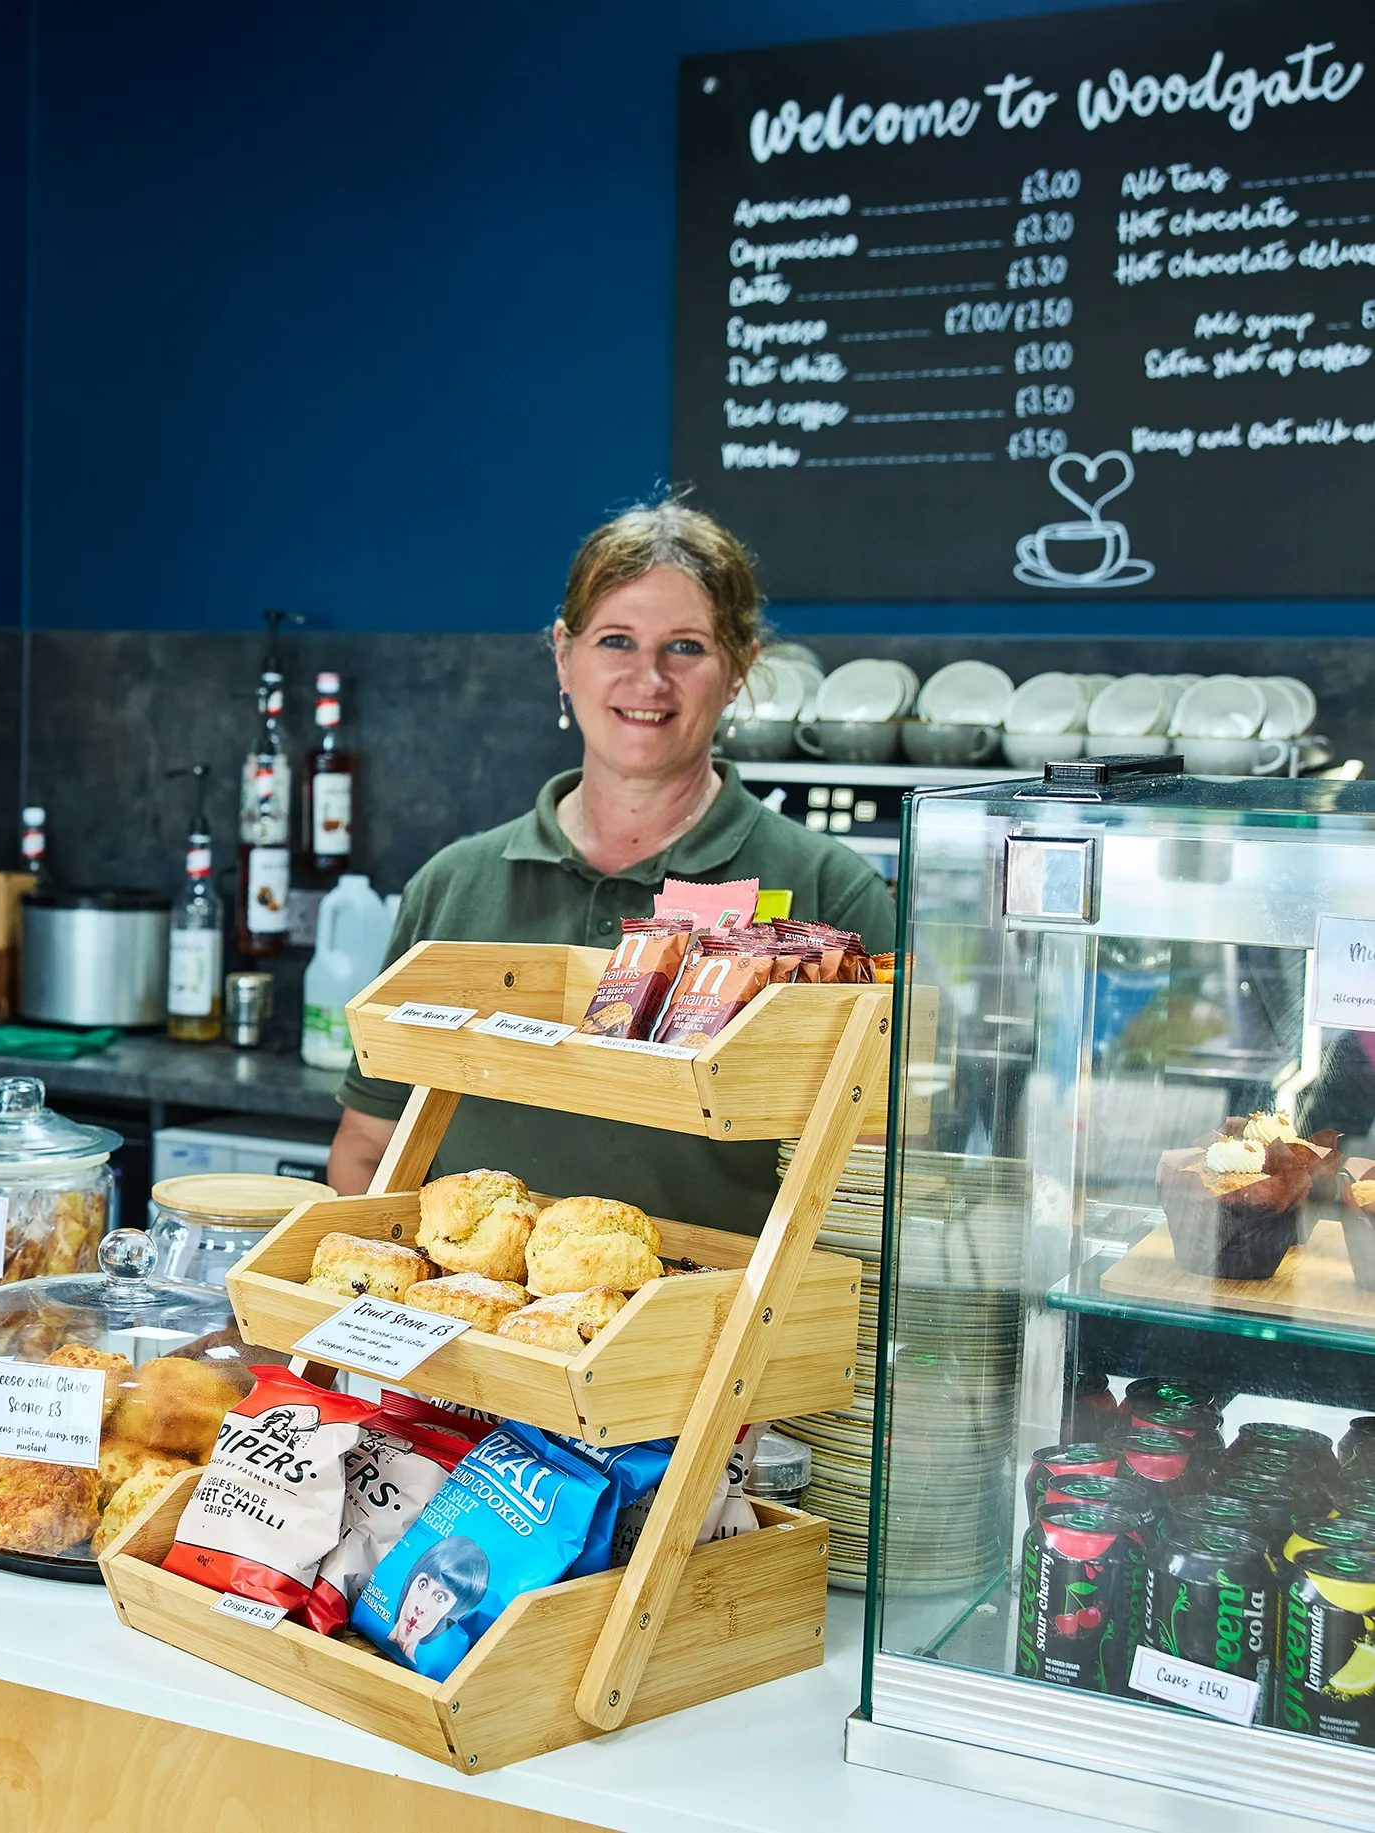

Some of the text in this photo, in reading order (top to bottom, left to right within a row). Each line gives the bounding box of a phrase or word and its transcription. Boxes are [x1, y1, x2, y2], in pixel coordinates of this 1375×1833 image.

[750, 41, 1365, 163] Welcome to Woodgate
[1121, 162, 1232, 201] All Teas
[733, 193, 852, 229] Americano
[1118, 195, 1300, 246] Hot chocolate
[729, 231, 860, 273] Cappuccino
[1114, 249, 1167, 287] Hot
[1168, 238, 1297, 280] chocolate
[729, 272, 792, 307] Latte
[726, 315, 828, 356] Espresso
[1194, 310, 1316, 343] Add syrup
[726, 354, 779, 387] Flat
[779, 352, 849, 384] white
[1144, 341, 1373, 380] Extra shot of coffee
[723, 397, 776, 429] Iced
[776, 399, 850, 433] coffee
[1197, 421, 1244, 450] and
[1296, 416, 1353, 446] milk
[721, 439, 802, 471] Mocha
[595, 994, 625, 1003] BREAKS
[607, 986, 637, 996] BISCUIT
[680, 994, 722, 1008] nairn's
[673, 1021, 705, 1031] BREAKS
[685, 1014, 717, 1025] BISCUIT
[353, 1300, 455, 1338] Fruit Scone £3
[27, 1374, 53, 1390] and
[55, 1375, 92, 1395] Chive
[8, 1395, 63, 1418] Scone £3
[15, 1426, 43, 1439] gluten,
[70, 1433, 93, 1446] eggs,
[16, 1442, 49, 1454] mustard
[237, 1466, 282, 1491] FARMERS
[470, 1433, 553, 1514] REAL
[203, 1503, 234, 1519] CRISPS
[221, 1492, 286, 1531] CHILLI
[429, 1495, 461, 1523] CIDER
[450, 1486, 480, 1514] SALT
[450, 1466, 534, 1537] HAND COOKED
[222, 1599, 277, 1621] Crisps £1.50
[1036, 1552, 1055, 1652] sour cherry
[1243, 1589, 1267, 1653] cola
[1283, 1581, 1312, 1731] green
[1304, 1604, 1326, 1694] lemonade
[1156, 1666, 1192, 1689] Cans
